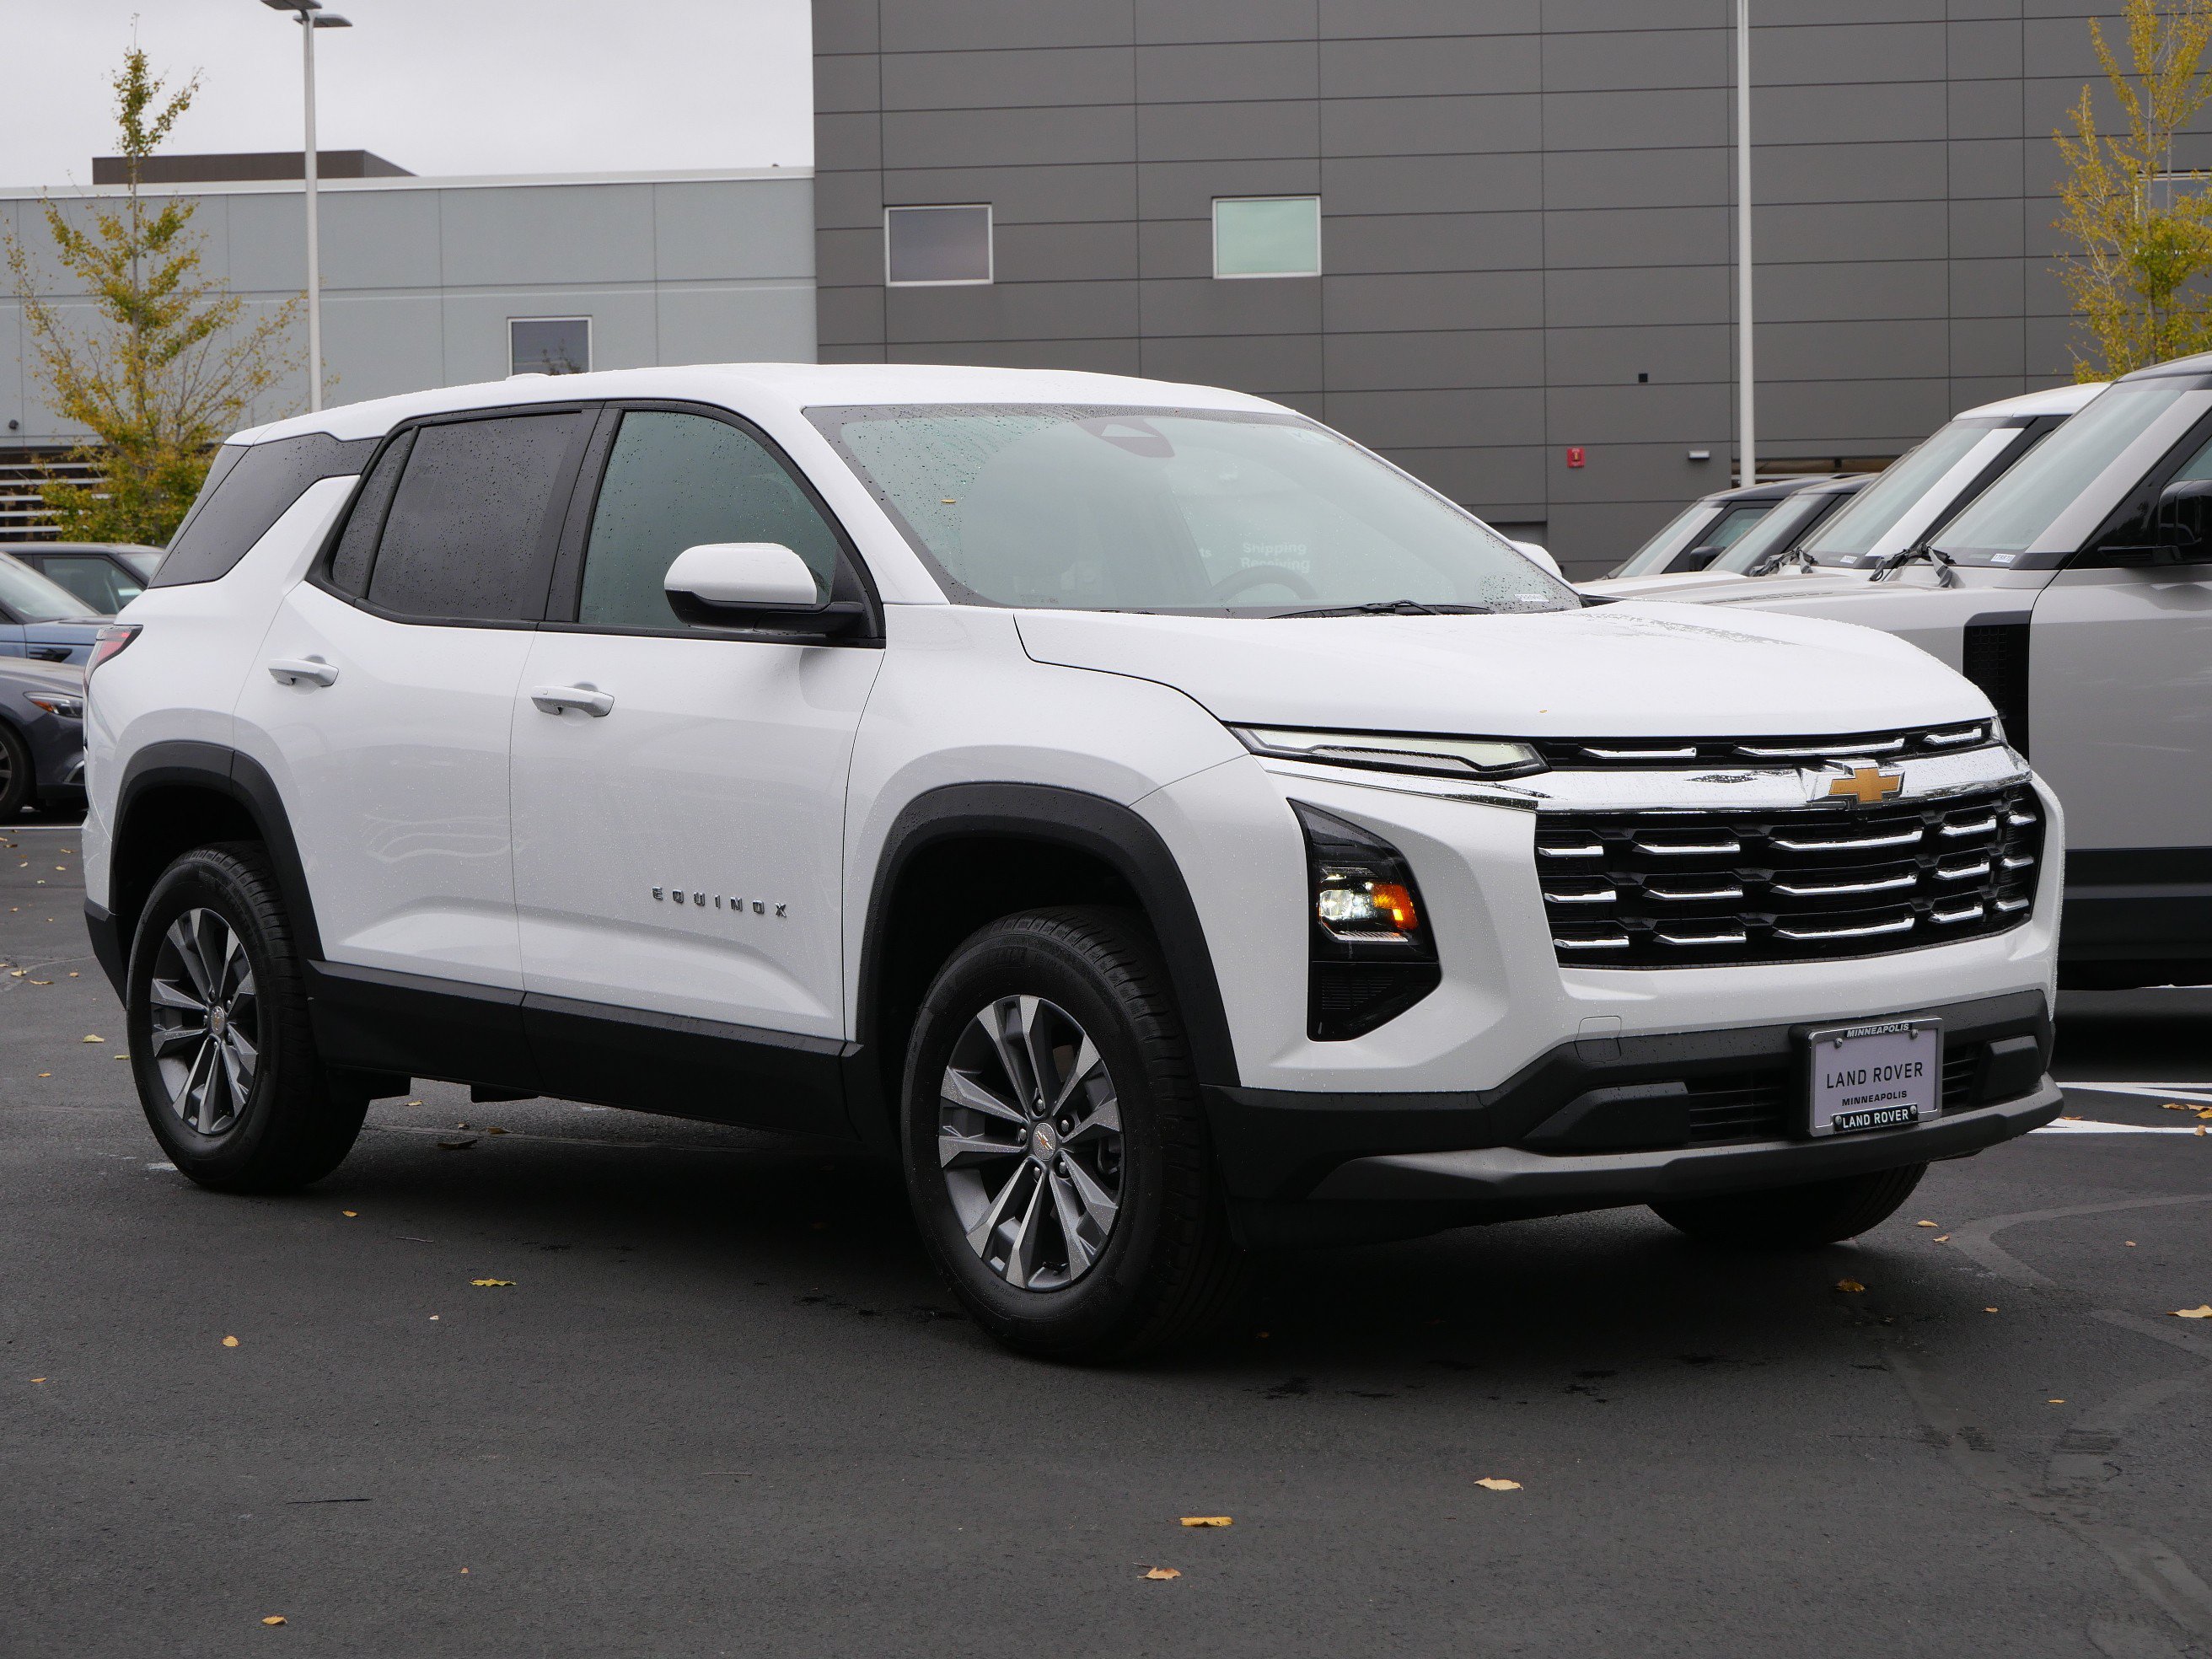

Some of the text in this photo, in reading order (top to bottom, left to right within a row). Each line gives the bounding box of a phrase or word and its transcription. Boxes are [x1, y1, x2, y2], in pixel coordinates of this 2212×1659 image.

[1243, 542, 1307, 556] Shipping
[652, 886, 787, 918] EQUINOX
[1846, 1023, 1910, 1039] MINNEAPOLIS
[1826, 1061, 1924, 1089] LAND ROVER
[1841, 1090, 1908, 1107] MINNEAPOLIS
[1842, 1109, 1909, 1129] LAND ROVER
